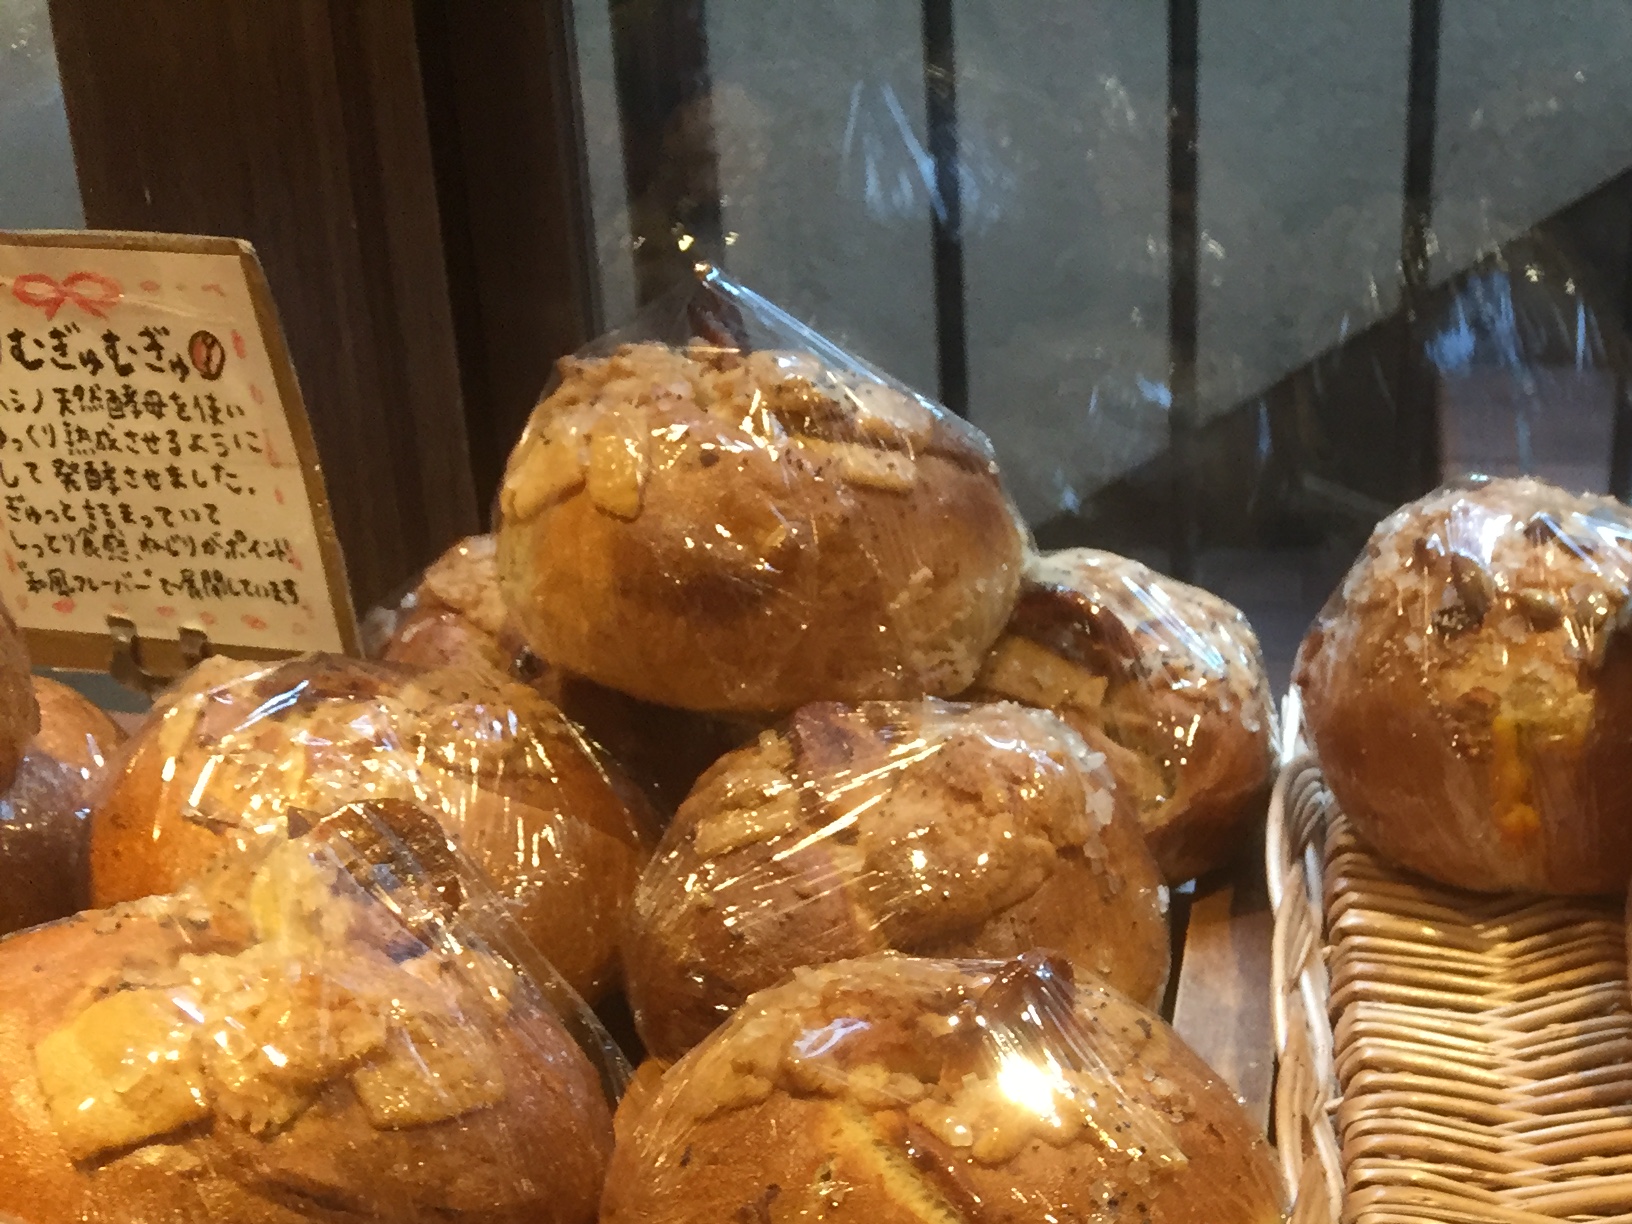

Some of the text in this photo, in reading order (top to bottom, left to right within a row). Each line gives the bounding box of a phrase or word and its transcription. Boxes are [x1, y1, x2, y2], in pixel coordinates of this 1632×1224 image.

[6, 321, 191, 383] むぎゅむぎゅ
[0, 383, 246, 426] シノ天然酵母を使い
